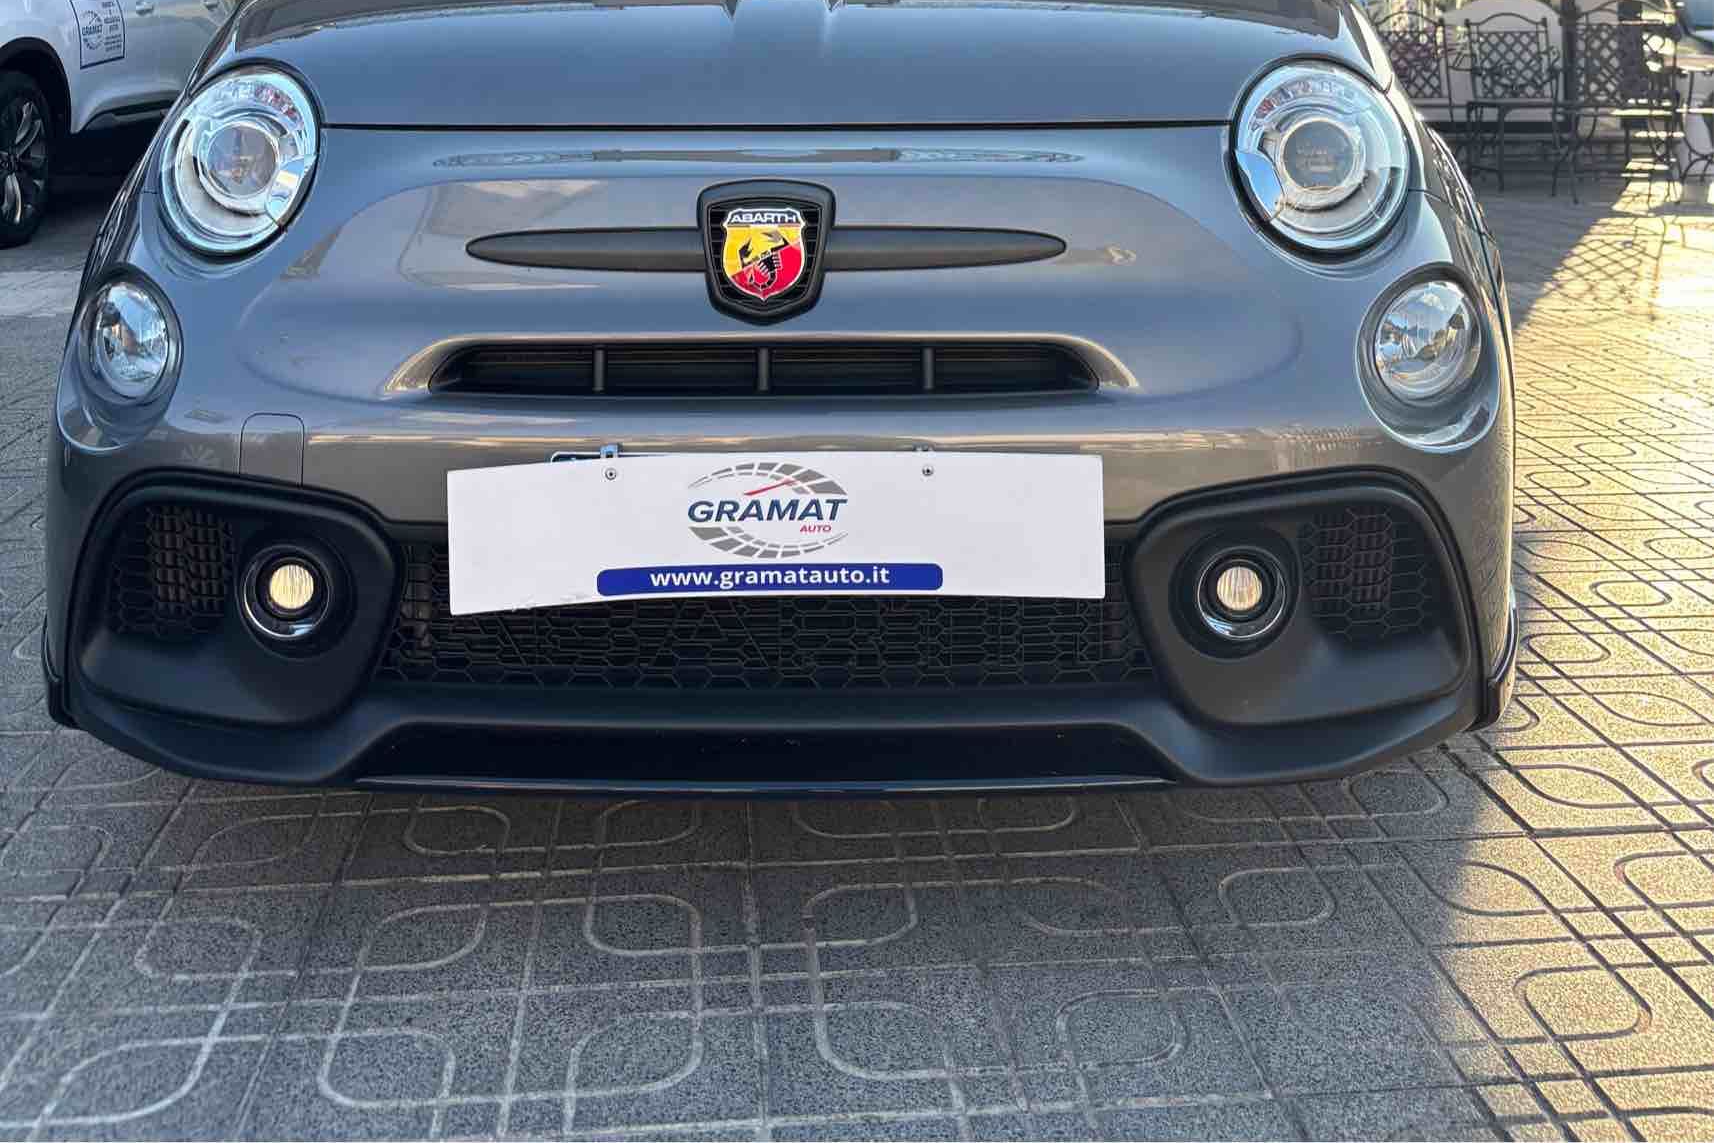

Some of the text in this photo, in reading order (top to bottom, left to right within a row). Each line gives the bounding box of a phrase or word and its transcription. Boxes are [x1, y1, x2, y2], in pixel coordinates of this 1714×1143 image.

[731, 213, 796, 223] ABARTH
[687, 498, 848, 522] GRAMAT
[799, 524, 832, 533] AUTO
[650, 566, 890, 589] www.gramatauto.it
